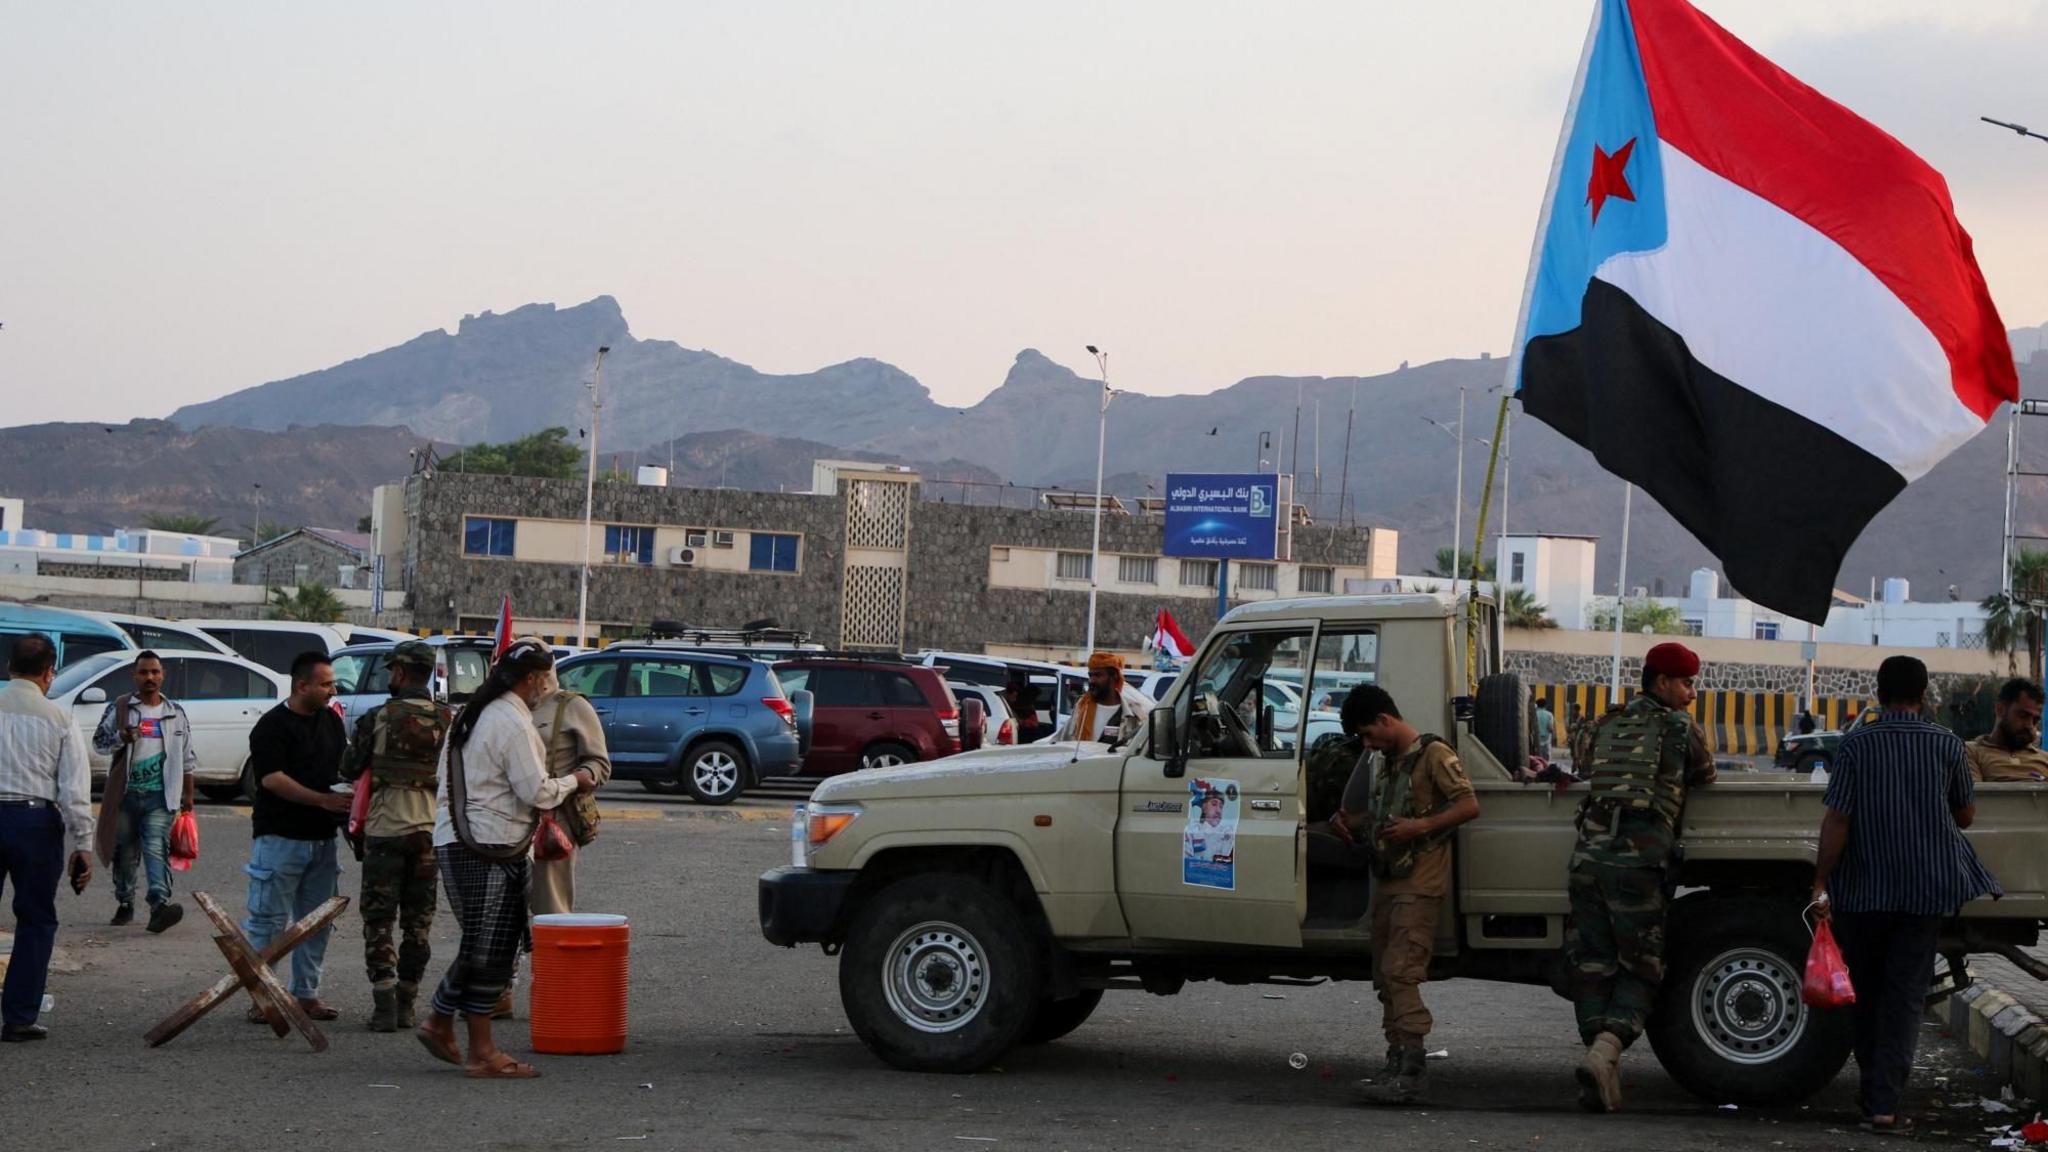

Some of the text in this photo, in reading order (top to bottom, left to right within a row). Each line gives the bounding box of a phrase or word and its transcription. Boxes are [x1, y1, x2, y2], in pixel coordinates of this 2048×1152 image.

[1171, 487, 1249, 502] بنك البسيري الدولي
[1193, 505, 1232, 513] INTERNATIONAL
